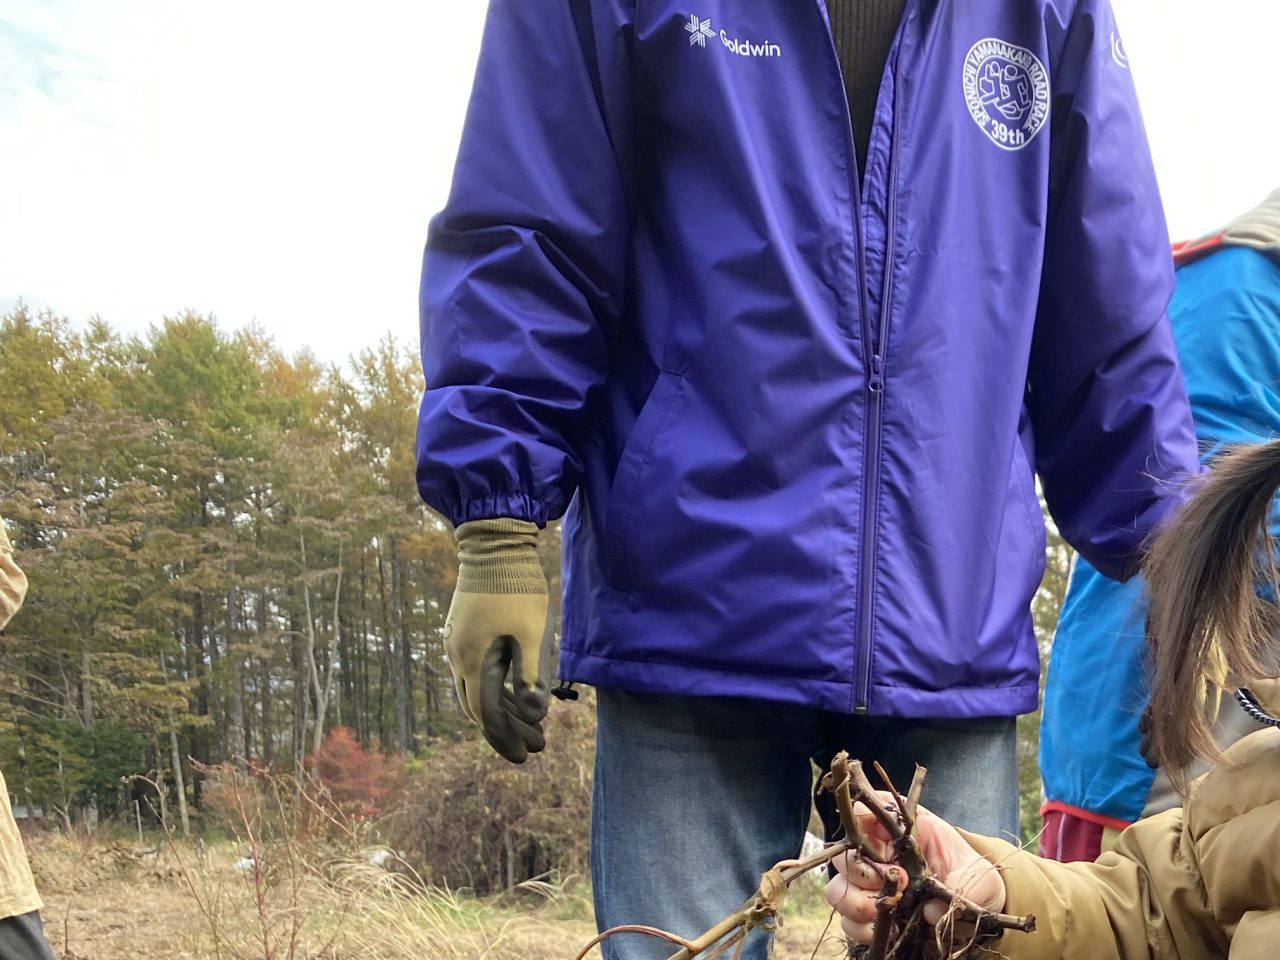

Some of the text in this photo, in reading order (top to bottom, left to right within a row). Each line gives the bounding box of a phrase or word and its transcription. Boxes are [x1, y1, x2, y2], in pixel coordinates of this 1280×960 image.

[720, 29, 781, 56] Goldwin
[1029, 62, 1046, 99] ROAD
[991, 119, 1025, 145] 39th
[1023, 101, 1047, 134] RACE
